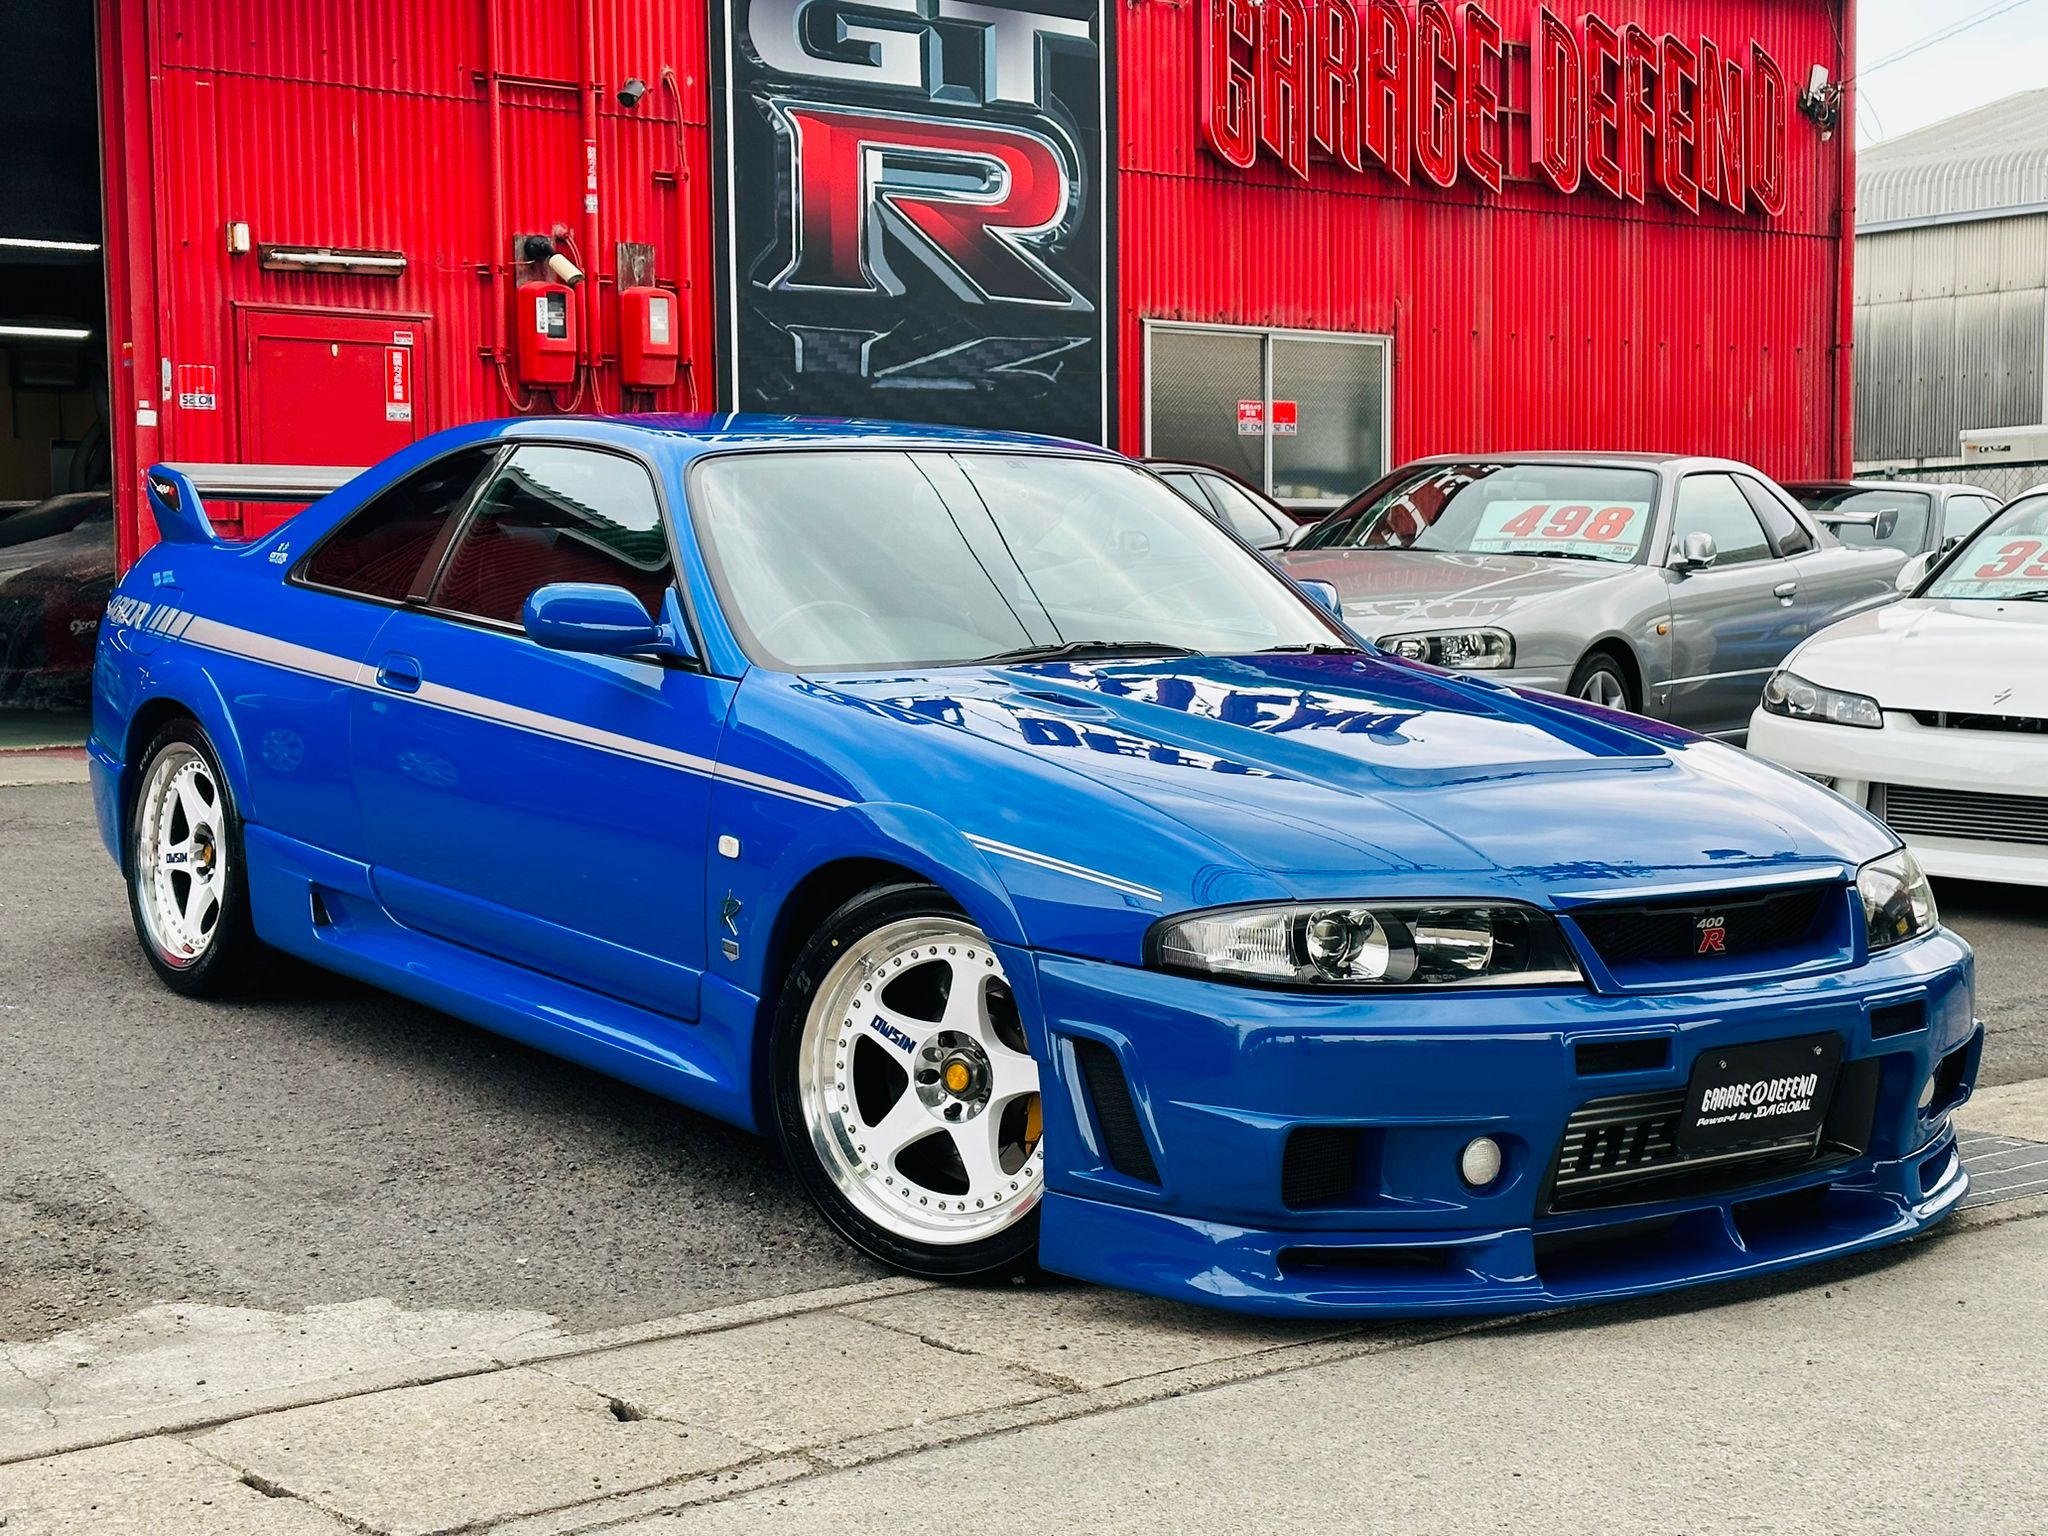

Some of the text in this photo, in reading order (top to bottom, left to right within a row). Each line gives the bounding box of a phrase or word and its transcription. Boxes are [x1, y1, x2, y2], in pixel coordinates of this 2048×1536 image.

[748, 0, 1096, 109] GT
[1204, 0, 1785, 216] GARAGE DEFEND
[752, 95, 1095, 311] R
[182, 395, 213, 405] SEOM
[1240, 423, 1262, 431] SEOM
[1273, 423, 1295, 431] SEOM
[1499, 504, 1635, 540] 498
[1696, 916, 1725, 928] 400
[1698, 927, 1726, 953] R
[870, 1014, 918, 1055] NISMO
[1701, 1082, 1751, 1112] GARAGE
[1767, 1073, 1818, 1103] DEFEND
[1738, 1111, 1752, 1120] by
[1776, 1099, 1811, 1115] GLOBAL
